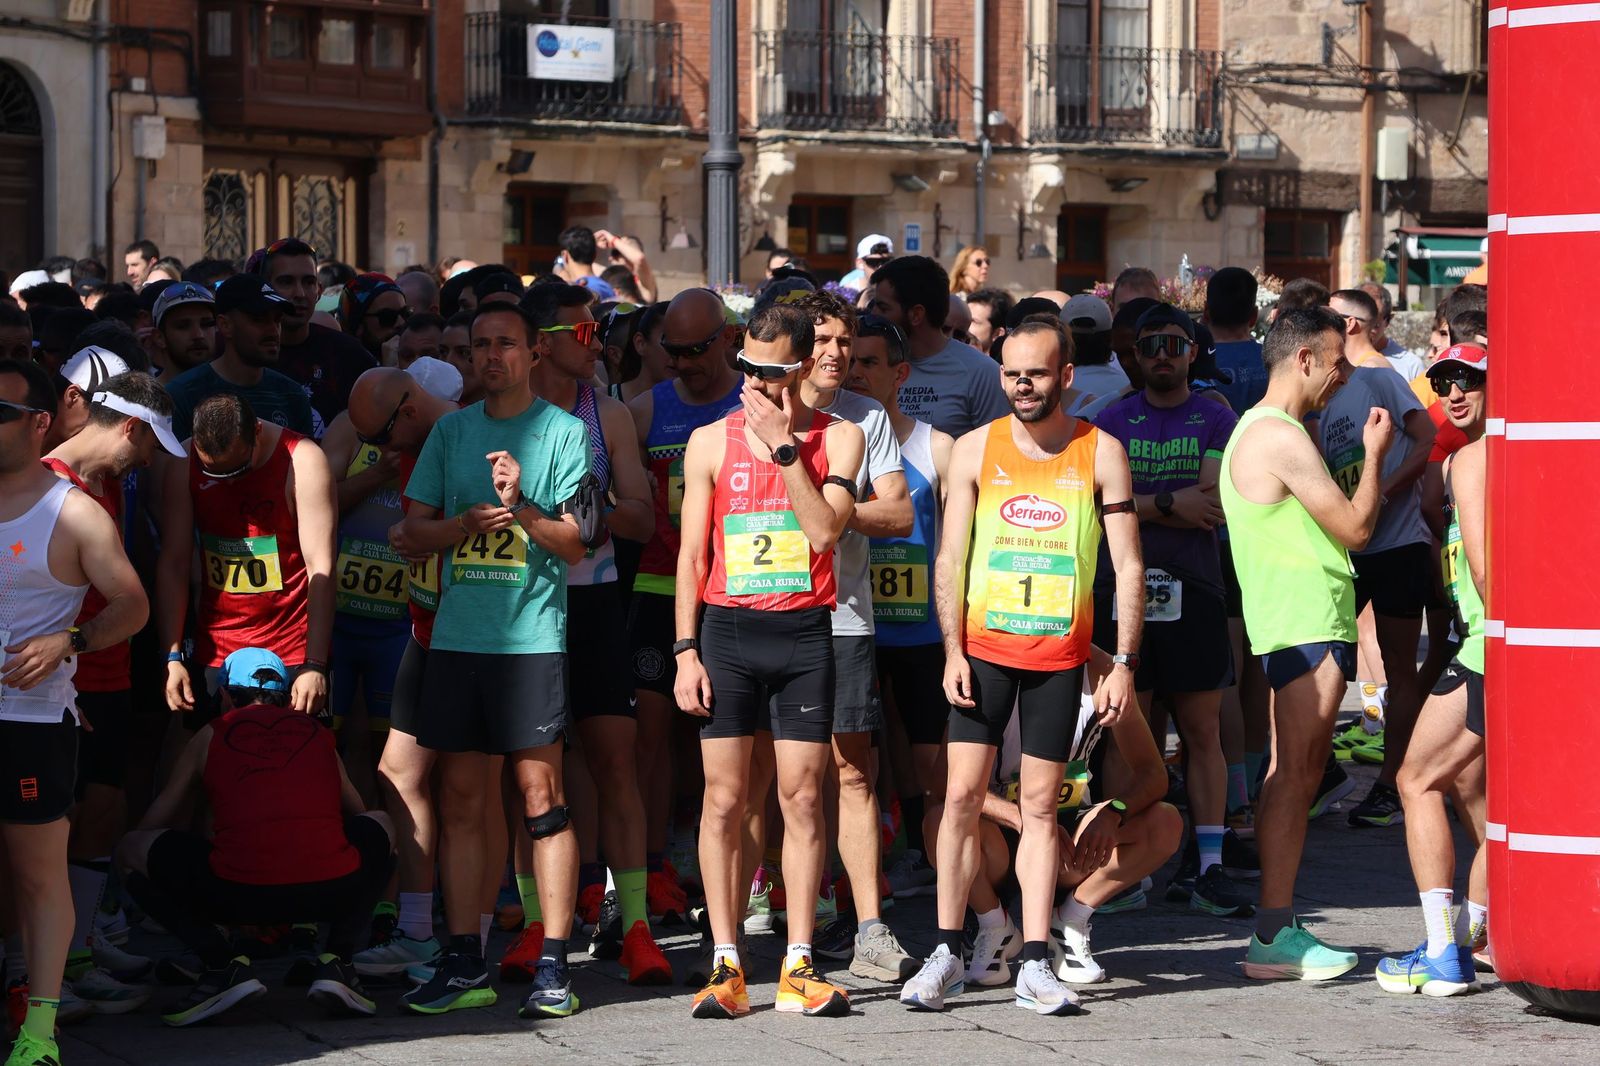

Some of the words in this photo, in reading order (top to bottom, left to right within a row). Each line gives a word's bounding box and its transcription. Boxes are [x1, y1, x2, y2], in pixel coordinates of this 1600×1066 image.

[904, 386, 934, 395] MEDIA
[1129, 437, 1199, 460] BEHOBIA
[1130, 460, 1149, 473] SAN
[1007, 503, 1062, 522] Serrano
[753, 534, 773, 566] 2
[995, 536, 1014, 545] COME
[1017, 537, 1034, 547] BIEN
[1037, 539, 1041, 547] Y
[1044, 540, 1068, 550] CORRE
[211, 556, 268, 588] 370
[341, 560, 404, 599] 564
[465, 571, 486, 579] CAJA
[488, 571, 520, 581] RURAL
[749, 578, 773, 588] CAJA
[775, 578, 806, 587] RURAL
[870, 567, 913, 597] 81
[1019, 575, 1032, 607] 1
[350, 599, 372, 611] CAJA
[373, 603, 401, 614] RURAL
[873, 608, 893, 616] CAJA
[895, 608, 924, 617] RURAL
[1010, 619, 1032, 629] CAJA
[1034, 621, 1066, 631] RURAL
